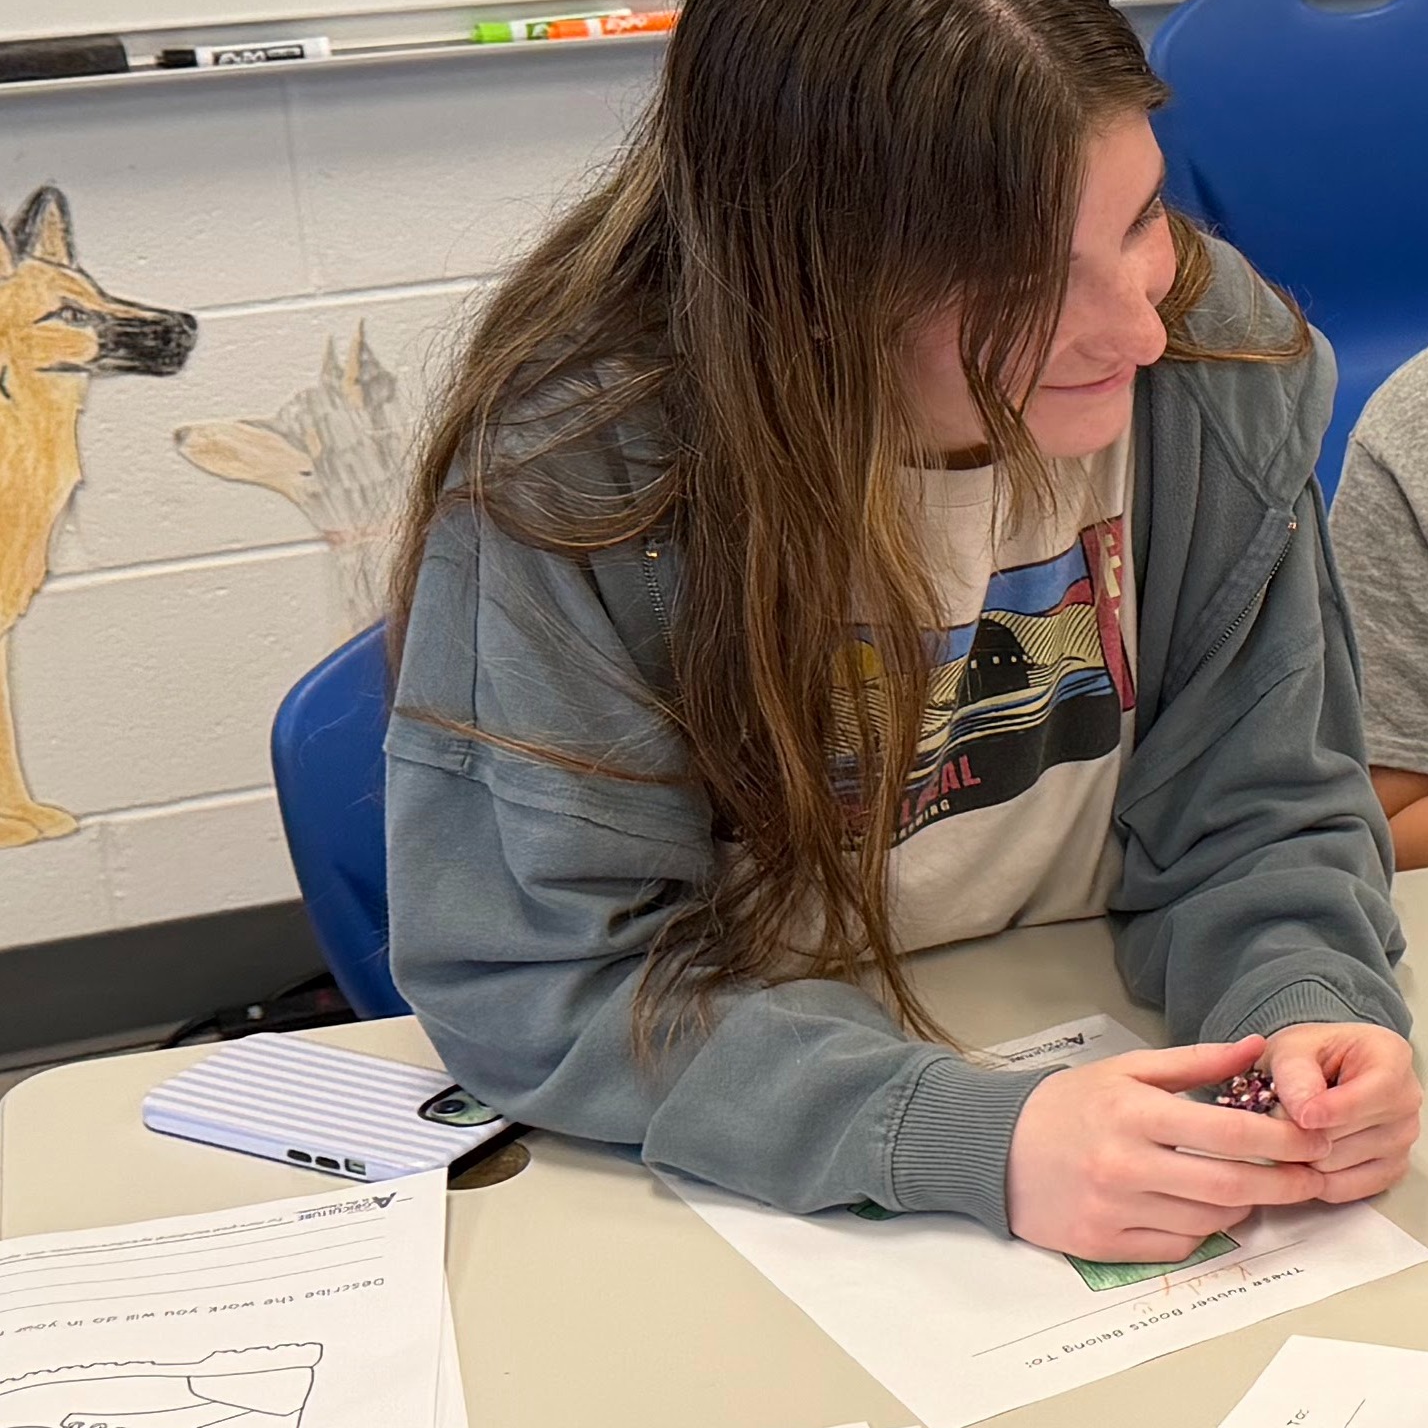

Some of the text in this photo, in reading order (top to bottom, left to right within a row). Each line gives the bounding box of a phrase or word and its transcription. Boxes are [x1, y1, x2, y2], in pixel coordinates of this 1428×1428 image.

[13, 1277, 385, 1335] Describe the work you will do in your
[1024, 1266, 1306, 1369] These Rubber Boots Belong To:
